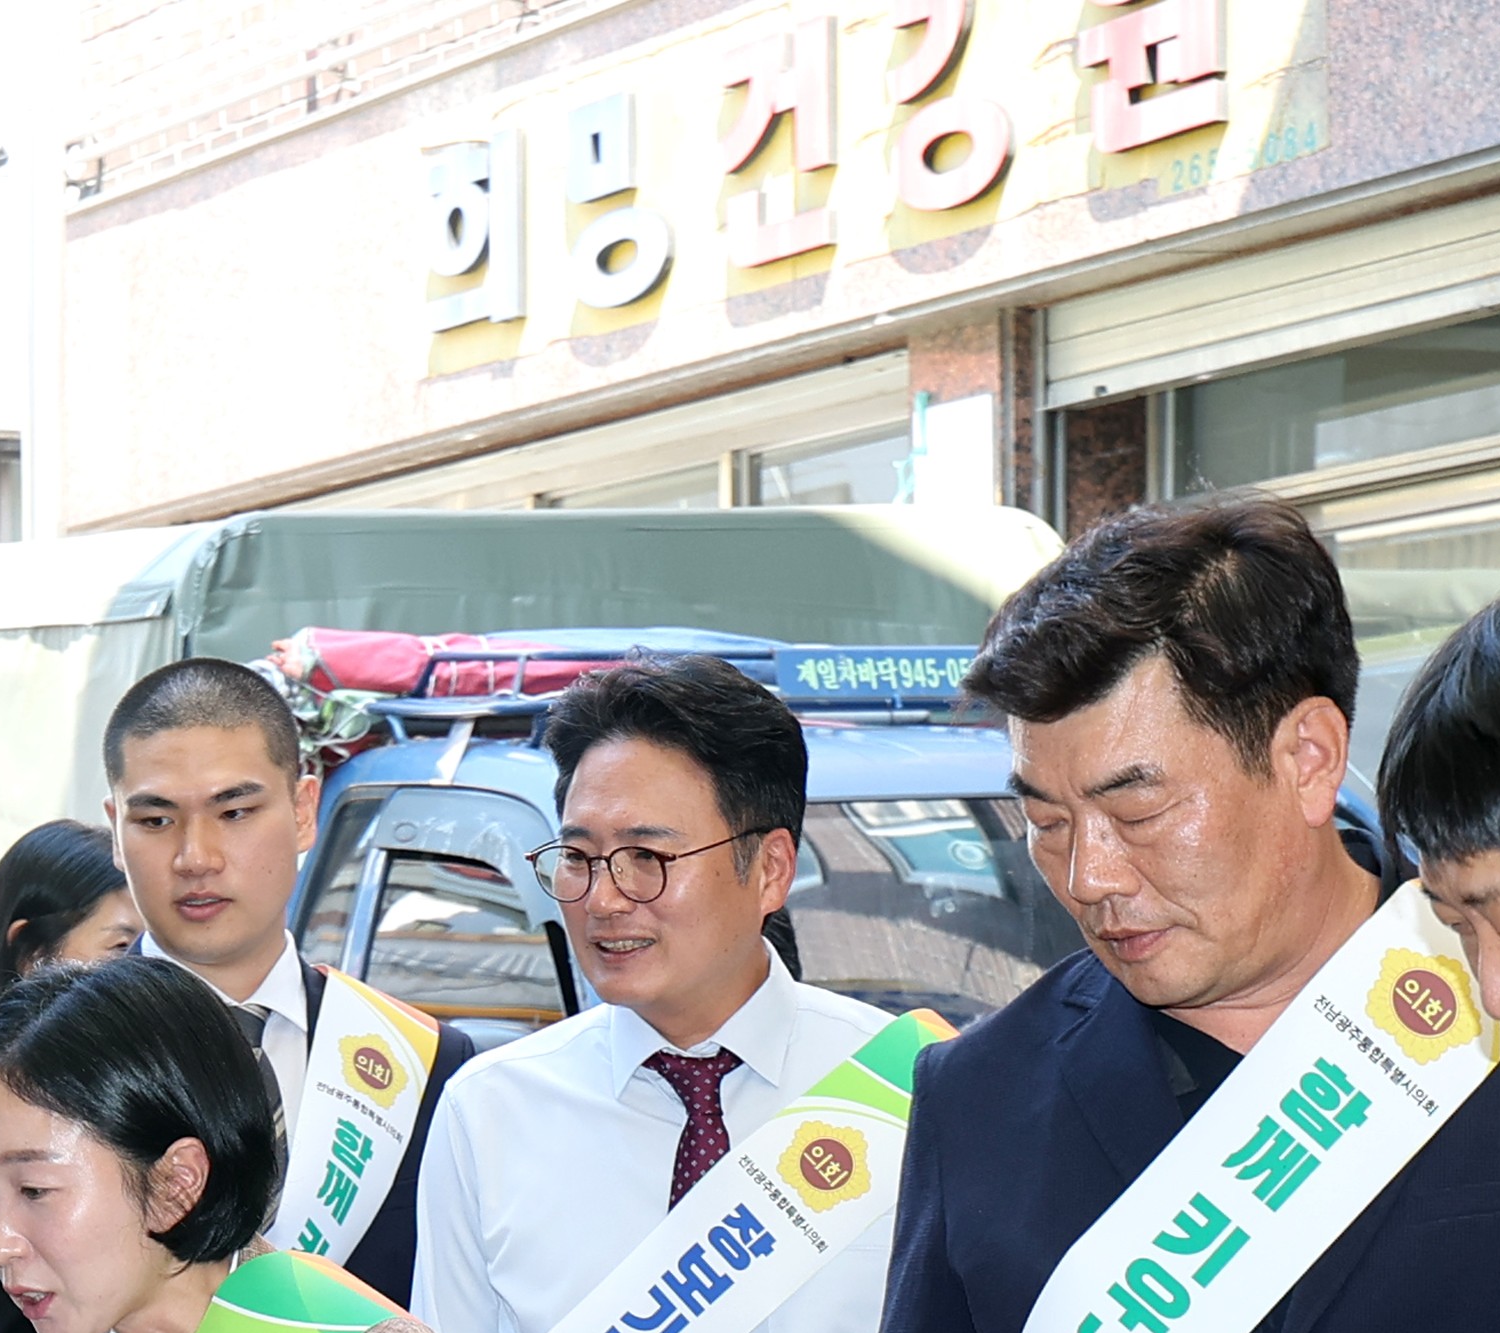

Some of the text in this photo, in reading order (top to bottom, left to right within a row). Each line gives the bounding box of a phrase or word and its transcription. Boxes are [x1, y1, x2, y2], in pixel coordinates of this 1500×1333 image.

[1394, 974, 1451, 1031] 의회
[355, 1052, 392, 1086] 의회
[1312, 992, 1441, 1119] 전남광주통합특별시의회
[316, 1116, 375, 1229] 함께
[808, 1144, 849, 1190] 의회
[1221, 1056, 1371, 1213] 함께
[738, 1152, 830, 1256] 전남광주통합특별시의회
